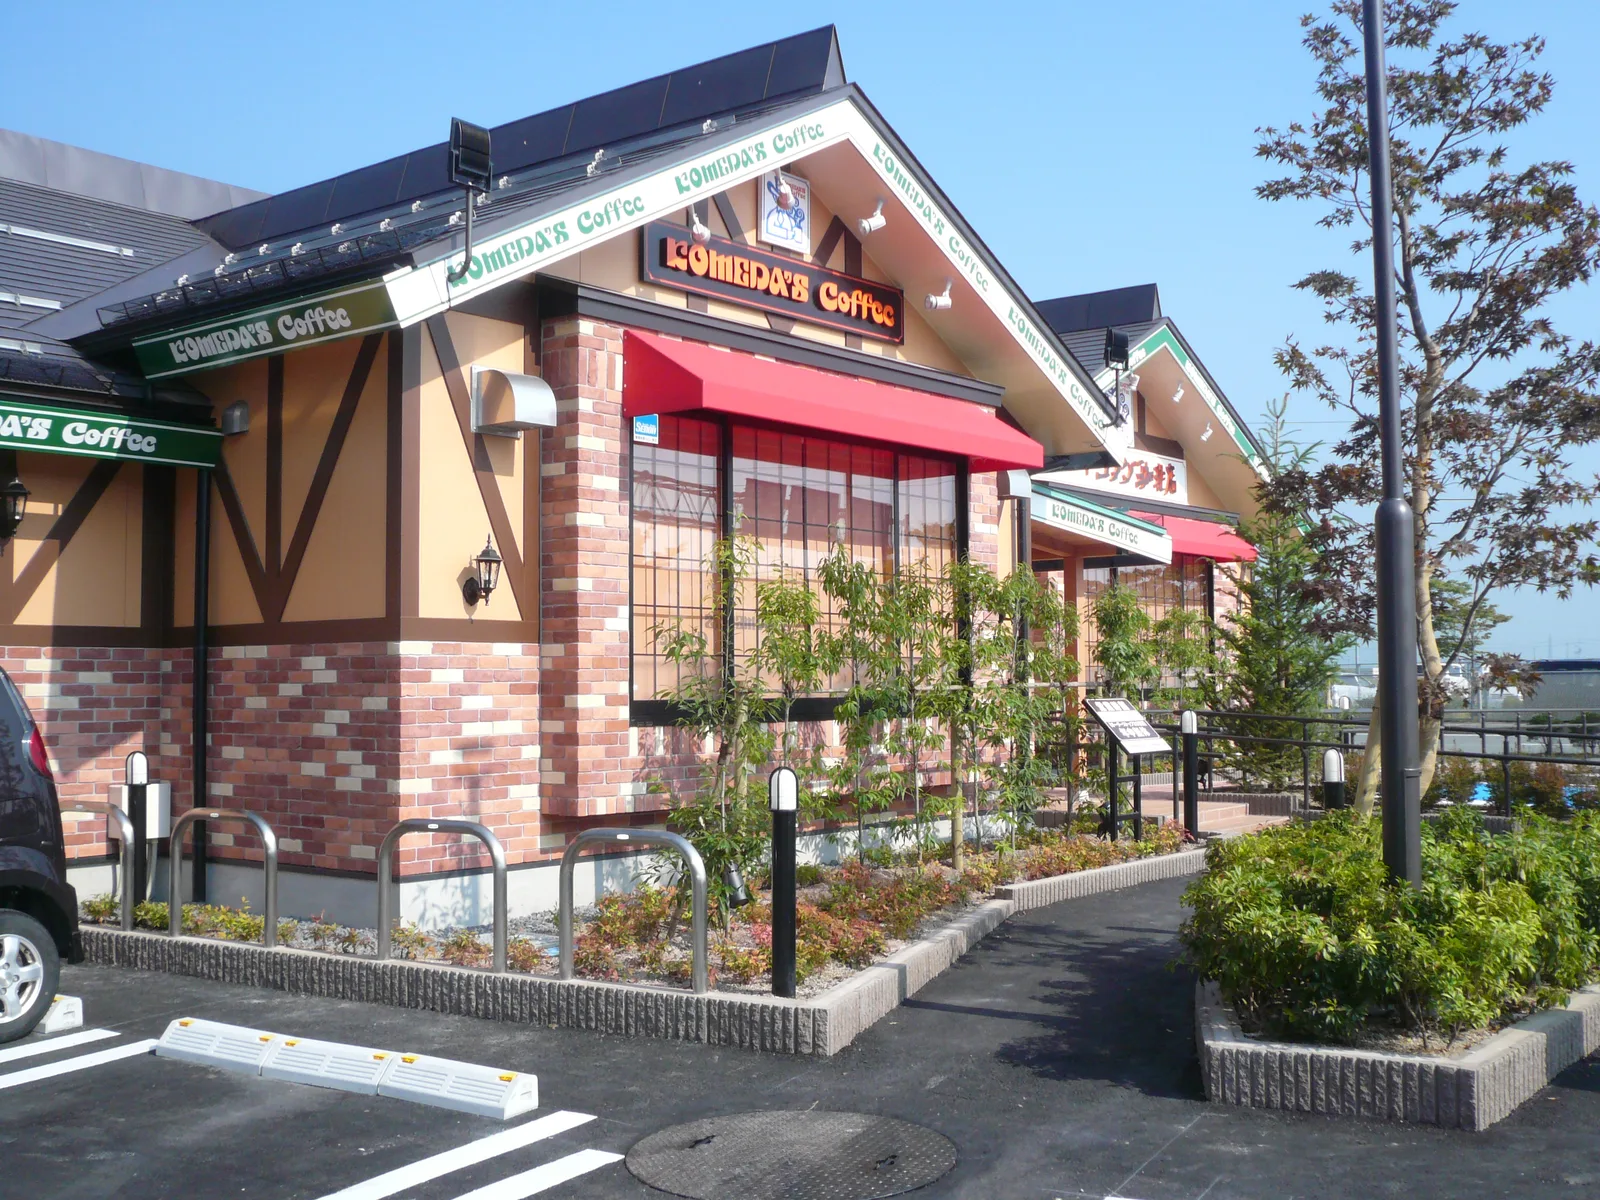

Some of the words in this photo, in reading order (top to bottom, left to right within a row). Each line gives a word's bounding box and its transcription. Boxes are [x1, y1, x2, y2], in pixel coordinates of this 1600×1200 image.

[675, 141, 767, 195] KOMEDA'S
[773, 122, 825, 155] Coffee
[577, 196, 645, 234] Coffee
[873, 142, 944, 236] KOMEDA'S
[948, 235, 989, 293] Coffee
[664, 236, 809, 303] KOMEDA'S
[816, 281, 895, 328] Coffee
[168, 320, 274, 364] KOMEDA'S
[277, 306, 352, 340] Coffee
[1007, 306, 1067, 385] KOMEDA'S
[1070, 383, 1105, 430] Coffee
[0, 414, 53, 440] A'S
[62, 422, 157, 453] Coffee
[1052, 503, 1104, 533] KOMEDA'S
[1108, 523, 1139, 545] Coffee
